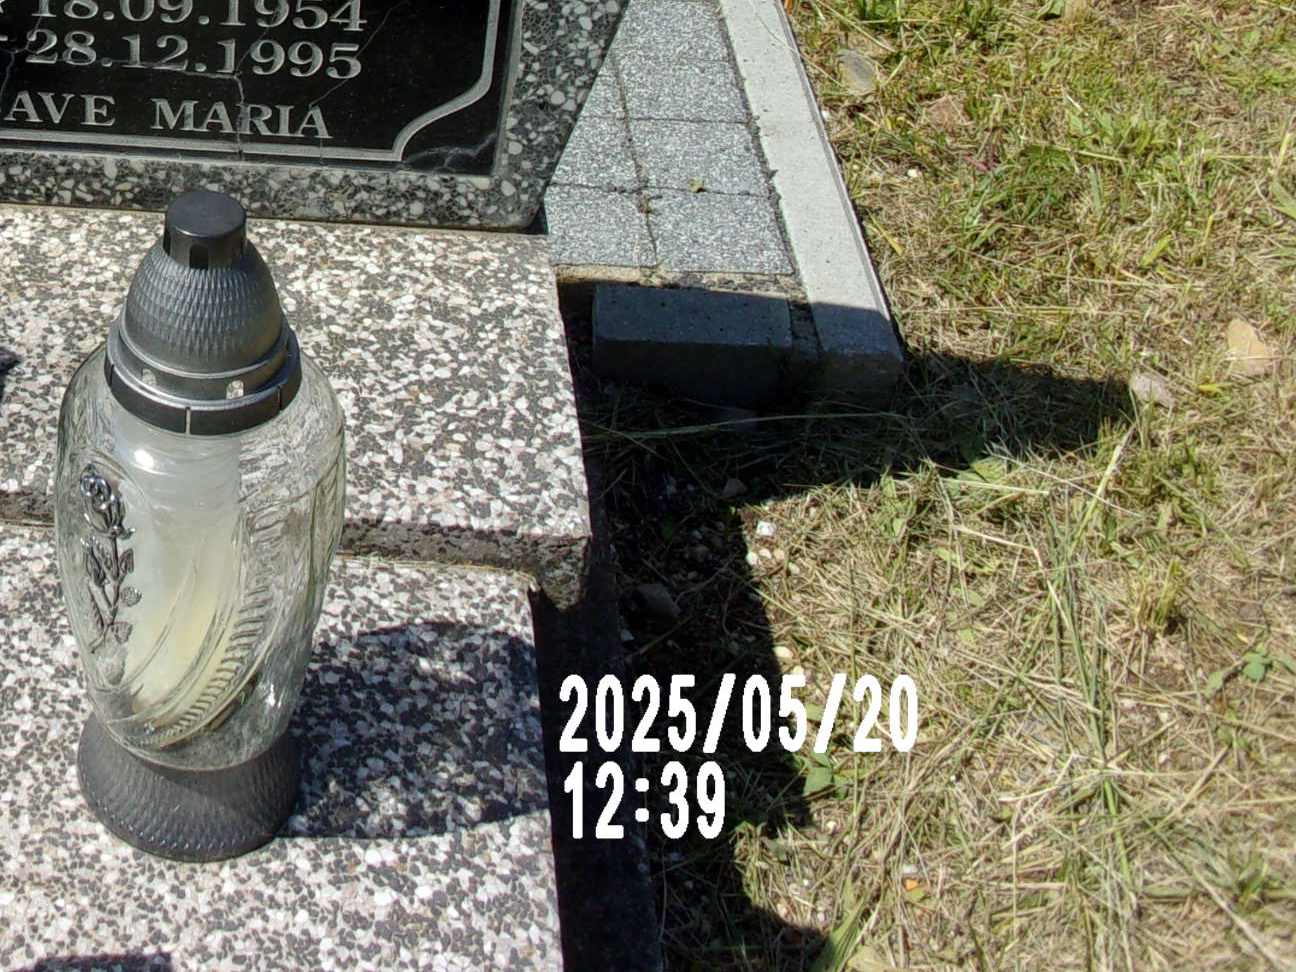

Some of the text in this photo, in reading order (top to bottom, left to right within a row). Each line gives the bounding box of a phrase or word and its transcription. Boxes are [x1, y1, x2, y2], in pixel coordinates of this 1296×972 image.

[24, 28, 364, 80] 28.12.1995
[3, 90, 333, 140] AVE MARIA
